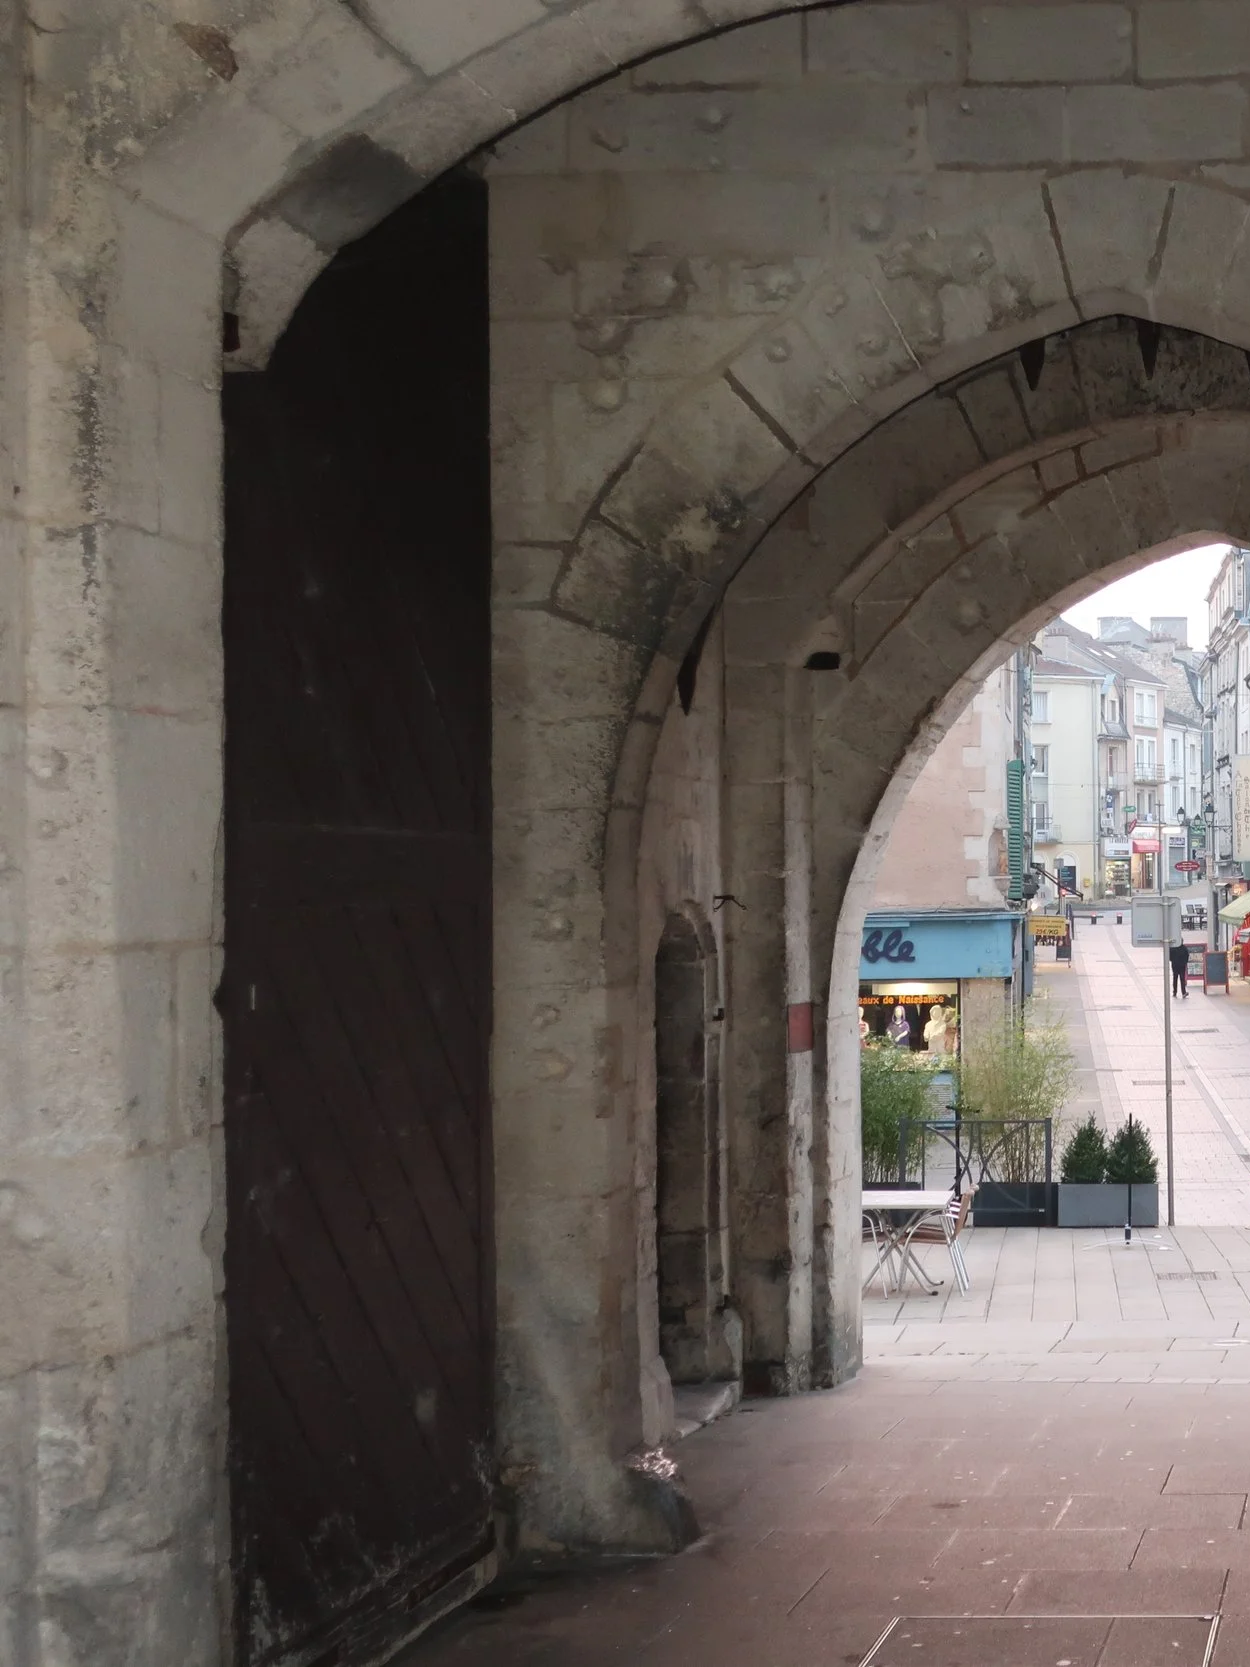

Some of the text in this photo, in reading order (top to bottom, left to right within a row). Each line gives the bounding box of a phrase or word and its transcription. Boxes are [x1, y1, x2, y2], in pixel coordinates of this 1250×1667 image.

[861, 929, 916, 964] ble
[857, 995, 945, 1005] eaux de Naissance
